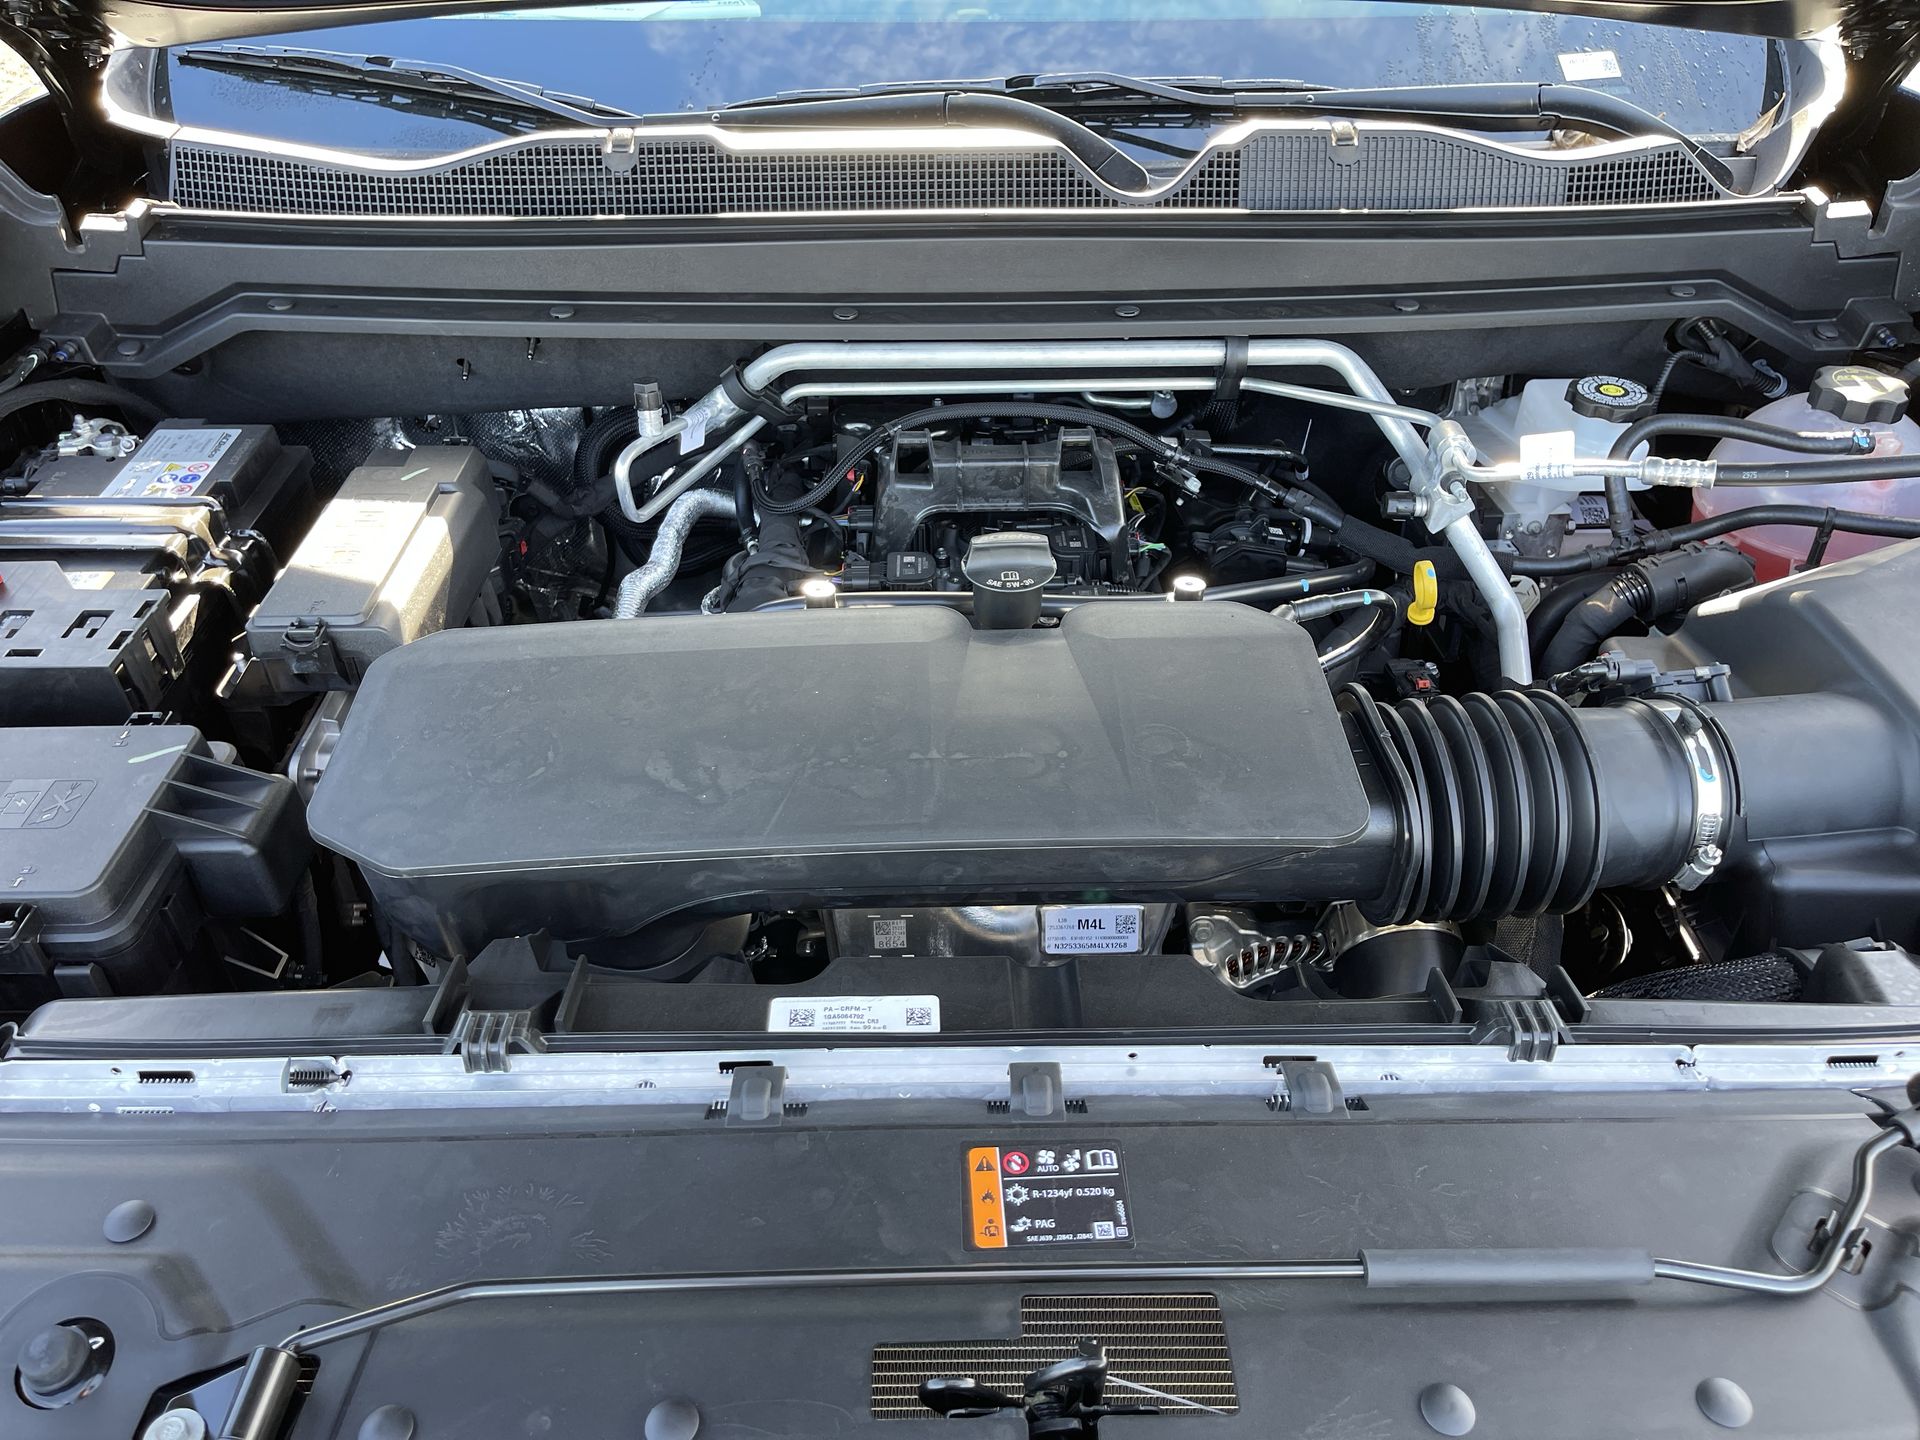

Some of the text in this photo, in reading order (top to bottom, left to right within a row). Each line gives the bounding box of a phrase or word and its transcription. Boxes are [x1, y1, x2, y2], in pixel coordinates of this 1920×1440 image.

[986, 578, 1034, 588] SAE 5W-30
[1077, 918, 1106, 930] M4L
[1037, 1164, 1059, 1172] AUTO
[1032, 1187, 1115, 1198] R-1234yf 0.520 kg
[1035, 1219, 1056, 1228] PAG
